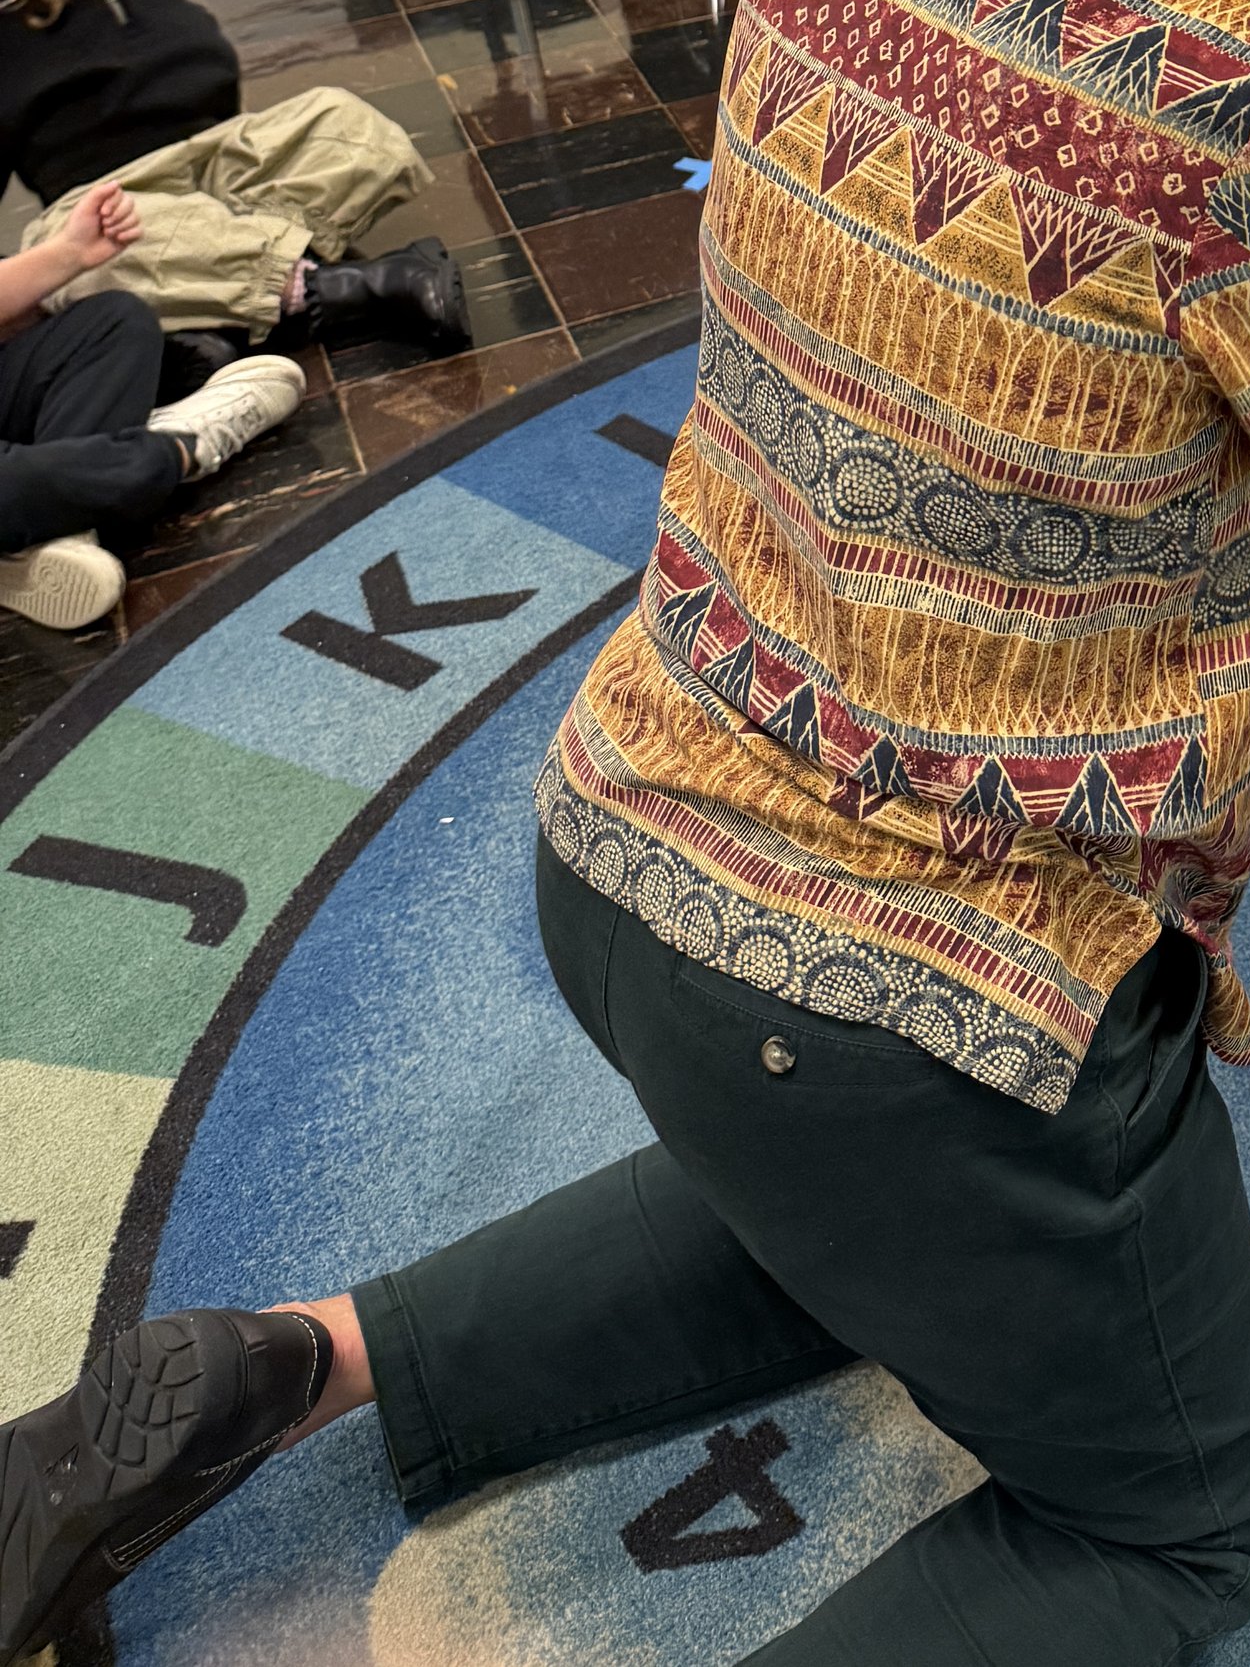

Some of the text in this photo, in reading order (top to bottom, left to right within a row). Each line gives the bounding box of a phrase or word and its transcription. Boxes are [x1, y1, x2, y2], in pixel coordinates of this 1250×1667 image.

[280, 550, 540, 692] K
[8, 835, 247, 948] J
[621, 1417, 804, 1575] 4
